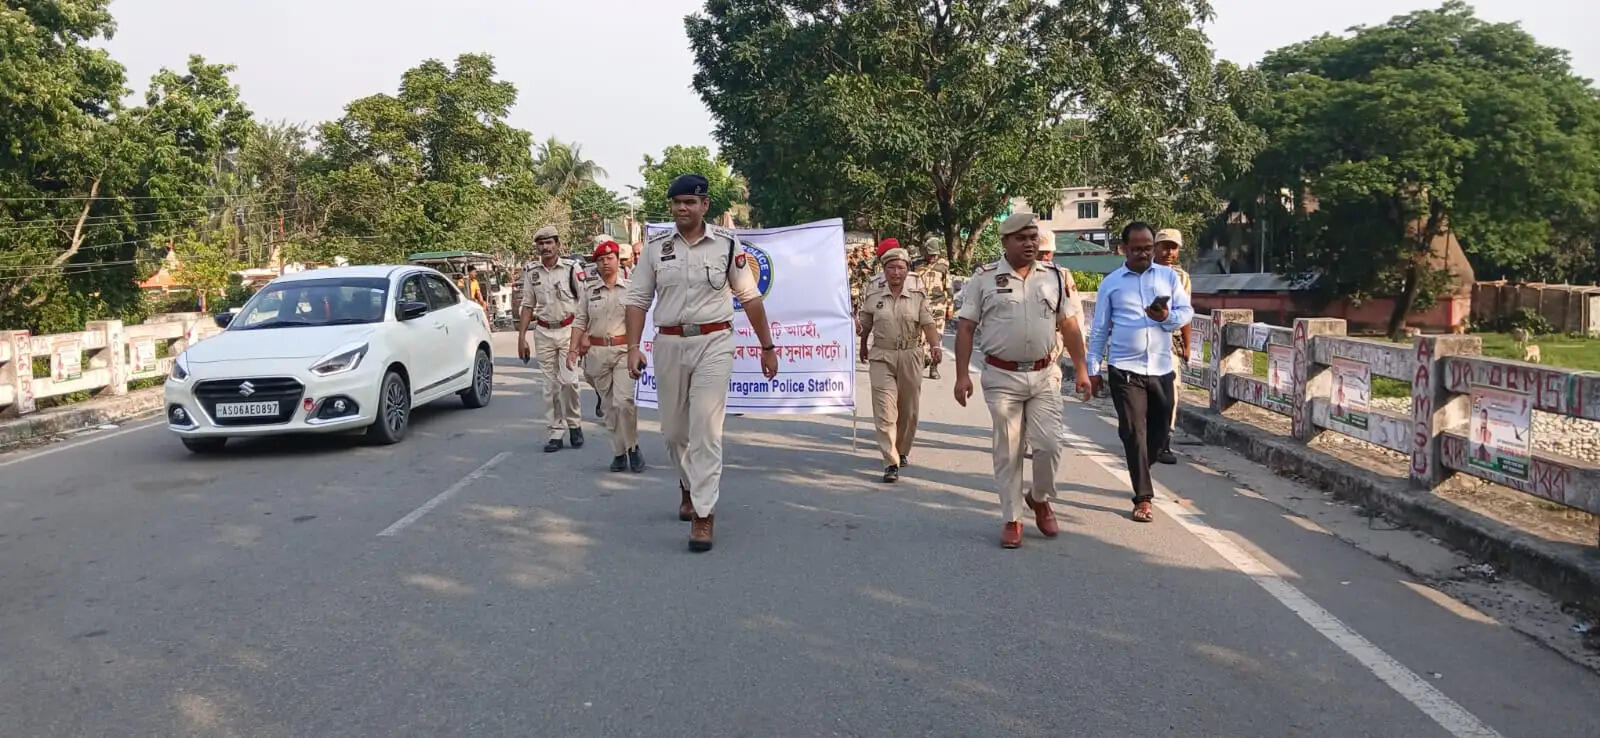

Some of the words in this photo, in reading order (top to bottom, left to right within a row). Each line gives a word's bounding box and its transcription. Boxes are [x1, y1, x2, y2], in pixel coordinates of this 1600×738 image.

[741, 245, 769, 271] POLICE
[784, 345, 813, 362] সুনাম
[728, 379, 769, 396] iragram
[772, 379, 805, 393] Police
[808, 378, 844, 393] Station
[222, 403, 278, 415] AS06AE0897
[1412, 337, 1431, 474] AAMSU
